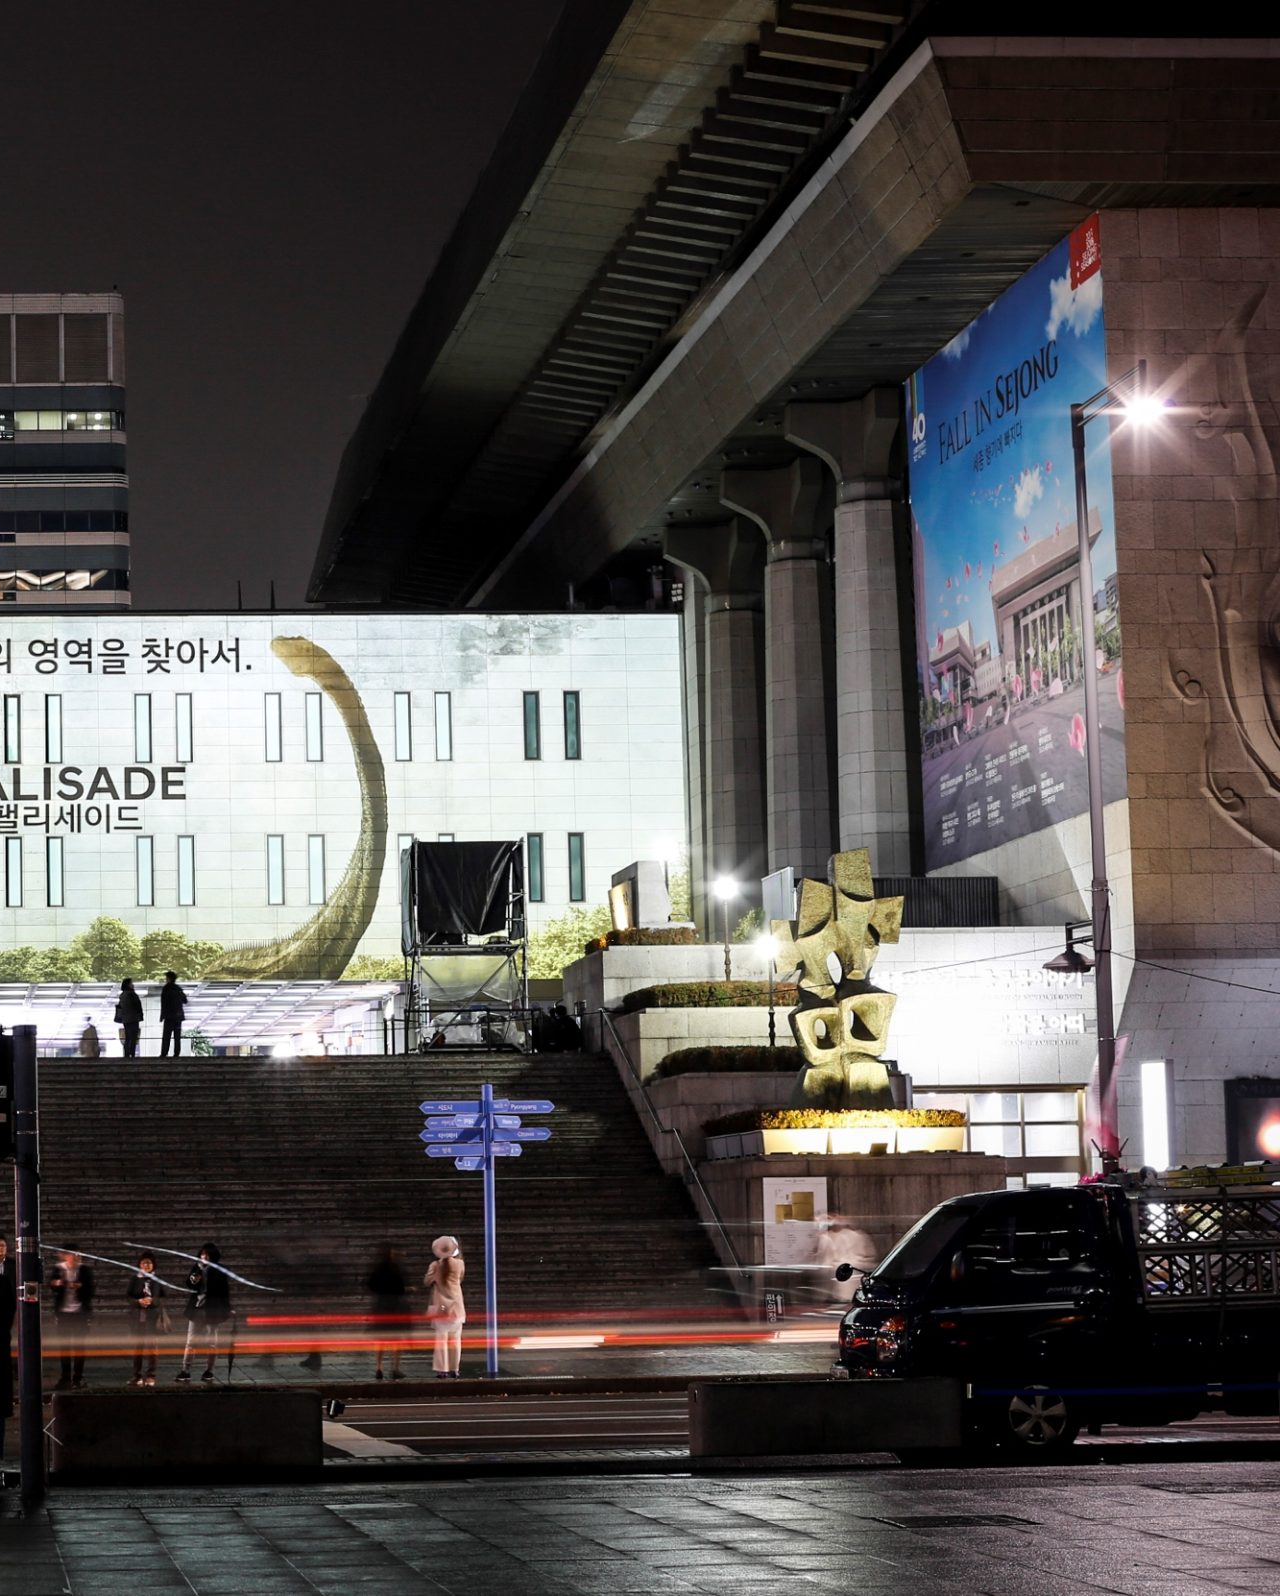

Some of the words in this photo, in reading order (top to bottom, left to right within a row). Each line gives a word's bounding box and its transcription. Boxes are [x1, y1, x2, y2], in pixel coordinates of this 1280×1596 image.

[938, 410, 972, 465] FALL
[975, 389, 992, 436] IN
[995, 339, 1059, 419] SEJONG
[27, 637, 130, 675] 영역을
[141, 636, 252, 675] 찾아서.
